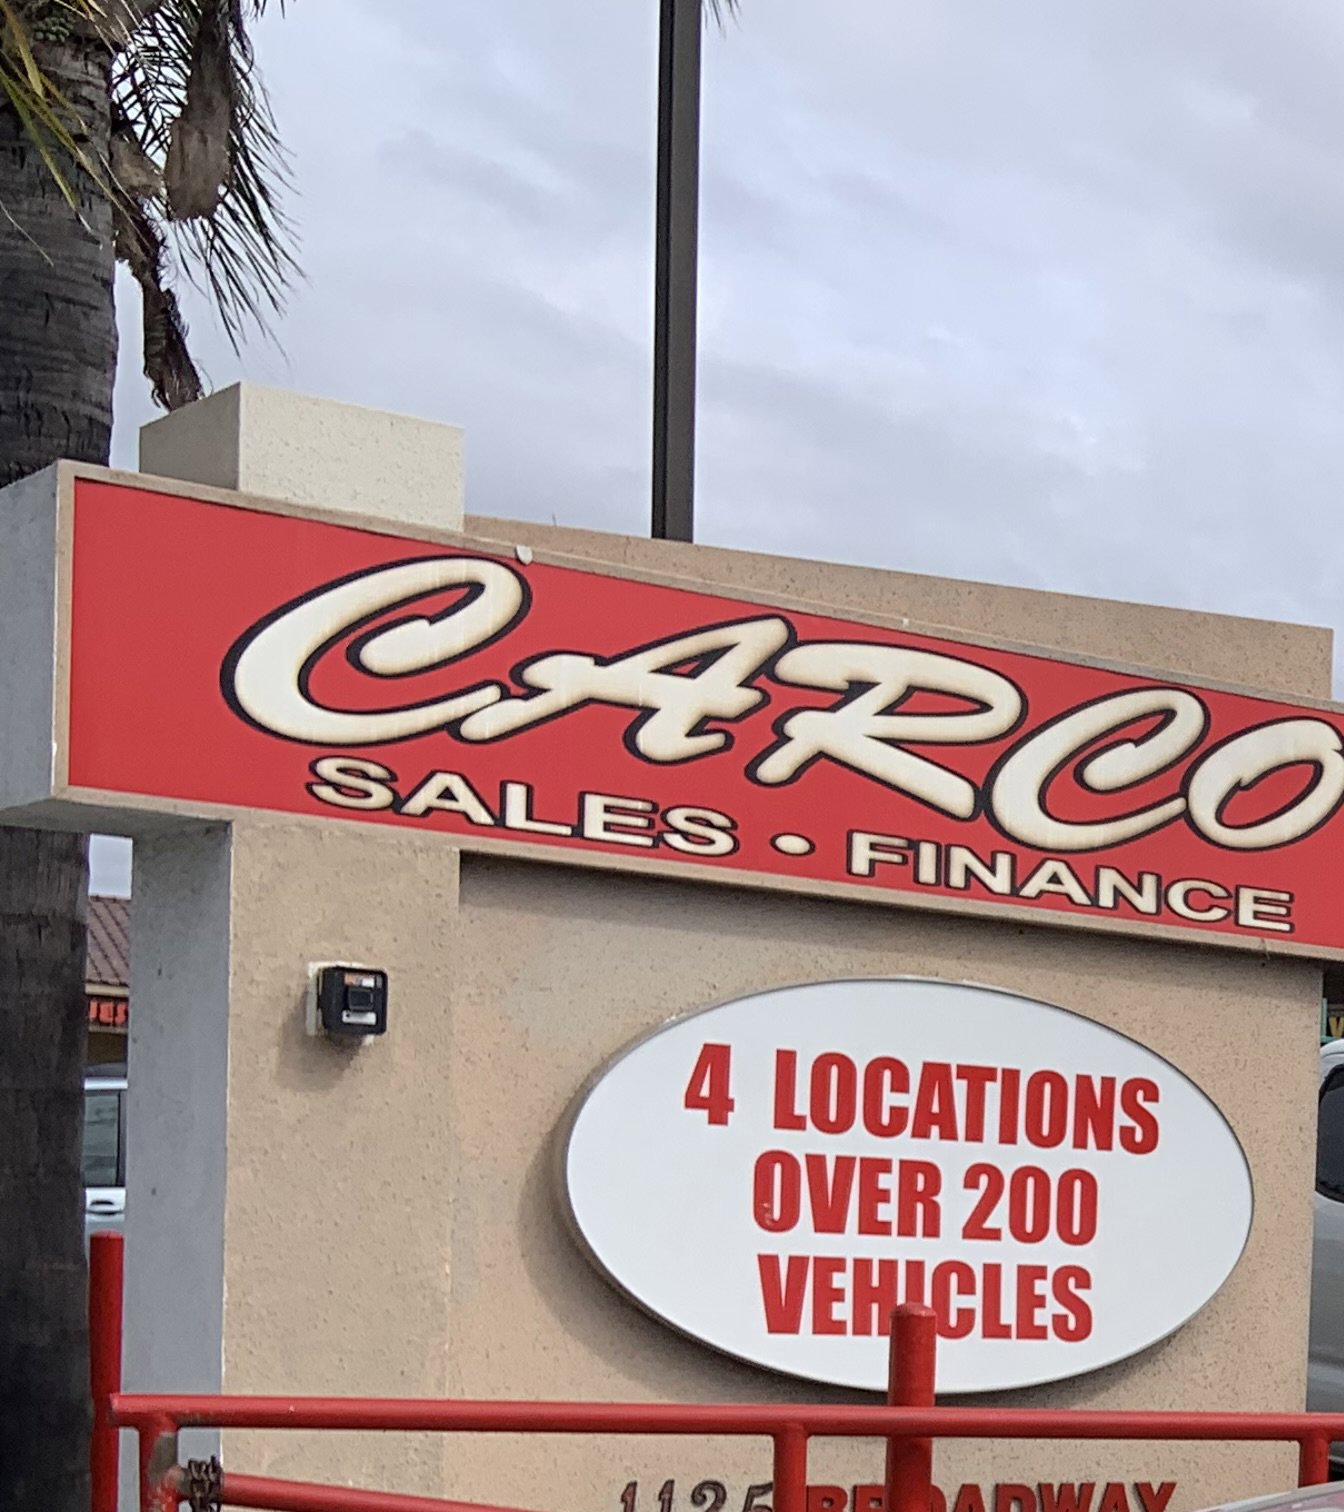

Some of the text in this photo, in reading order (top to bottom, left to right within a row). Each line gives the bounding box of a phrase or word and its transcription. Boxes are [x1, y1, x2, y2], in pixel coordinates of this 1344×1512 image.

[306, 756, 1295, 932] SALES FINANCE
[683, 1043, 1160, 1155] 4 LOCATIONS
[752, 1149, 1099, 1246] OVER 200
[757, 1253, 1094, 1343] VEHICLES
